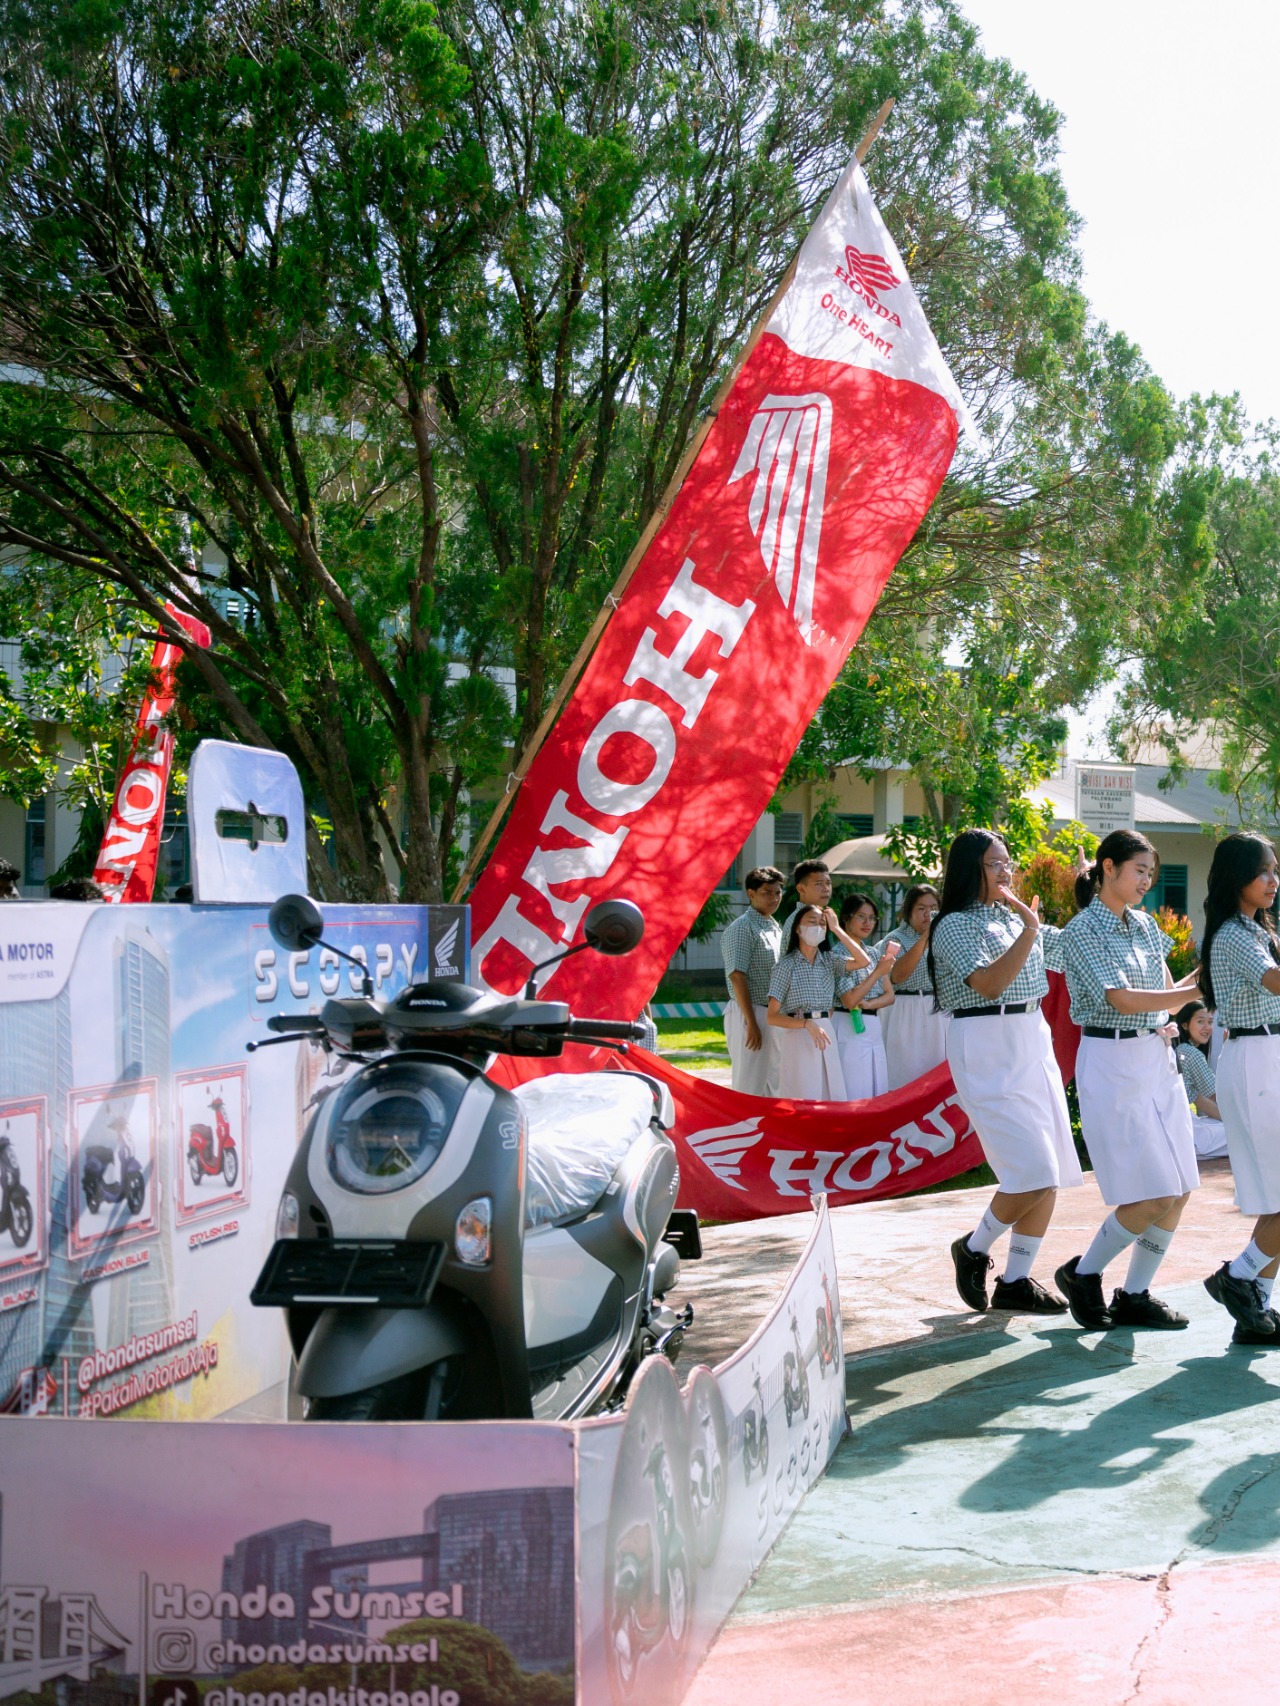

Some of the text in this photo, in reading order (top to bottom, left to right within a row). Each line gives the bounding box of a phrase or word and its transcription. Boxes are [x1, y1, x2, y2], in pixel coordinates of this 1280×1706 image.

[820, 293, 848, 321] One
[833, 265, 902, 329] HONDA
[8, 943, 54, 961] MOTOR
[255, 942, 418, 1002] SCOOPY
[434, 966, 460, 977] HONDA
[188, 1220, 239, 1246] STYLISH RED
[82, 1251, 149, 1280] FASHION BLUE
[3, 1287, 37, 1307] BLACK
[78, 1310, 198, 1392] @hondasumsel
[79, 1340, 219, 1418] #PakaiMotorkuXAja
[153, 1584, 463, 1619] Honda Sumsel
[203, 1638, 439, 1672] @hondasumsel
